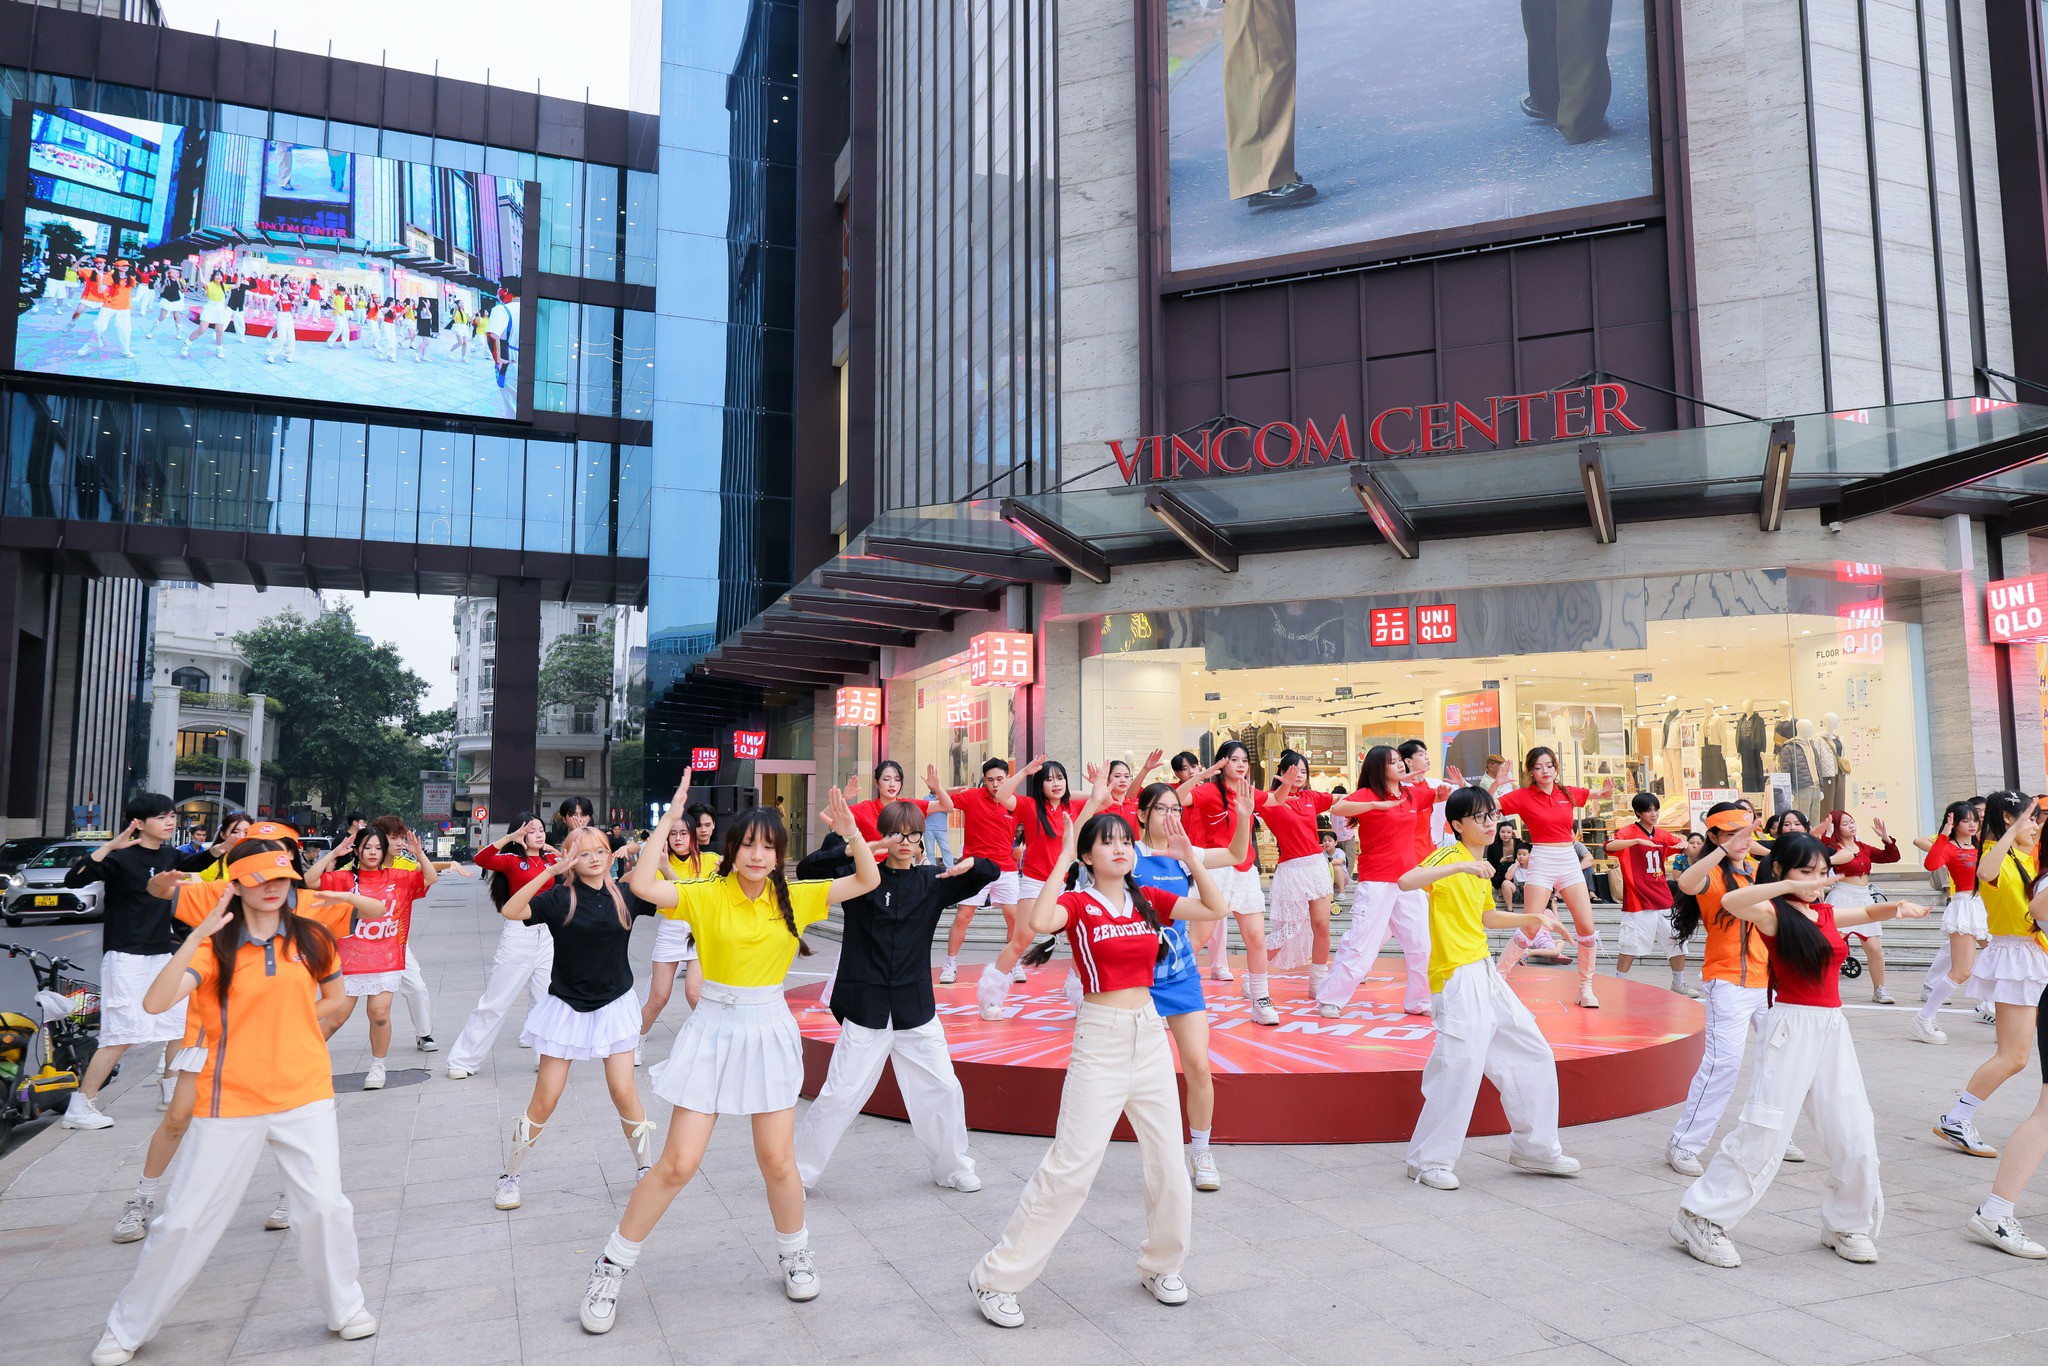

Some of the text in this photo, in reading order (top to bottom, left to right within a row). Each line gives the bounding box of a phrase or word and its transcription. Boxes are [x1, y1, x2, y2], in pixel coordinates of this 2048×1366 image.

[1105, 383, 1647, 485] VINCOM CENTER
[1991, 582, 2035, 610] UNI
[1994, 607, 2042, 638] QLO
[1816, 649, 1840, 659] FLOOR
[1645, 850, 1661, 873] 11
